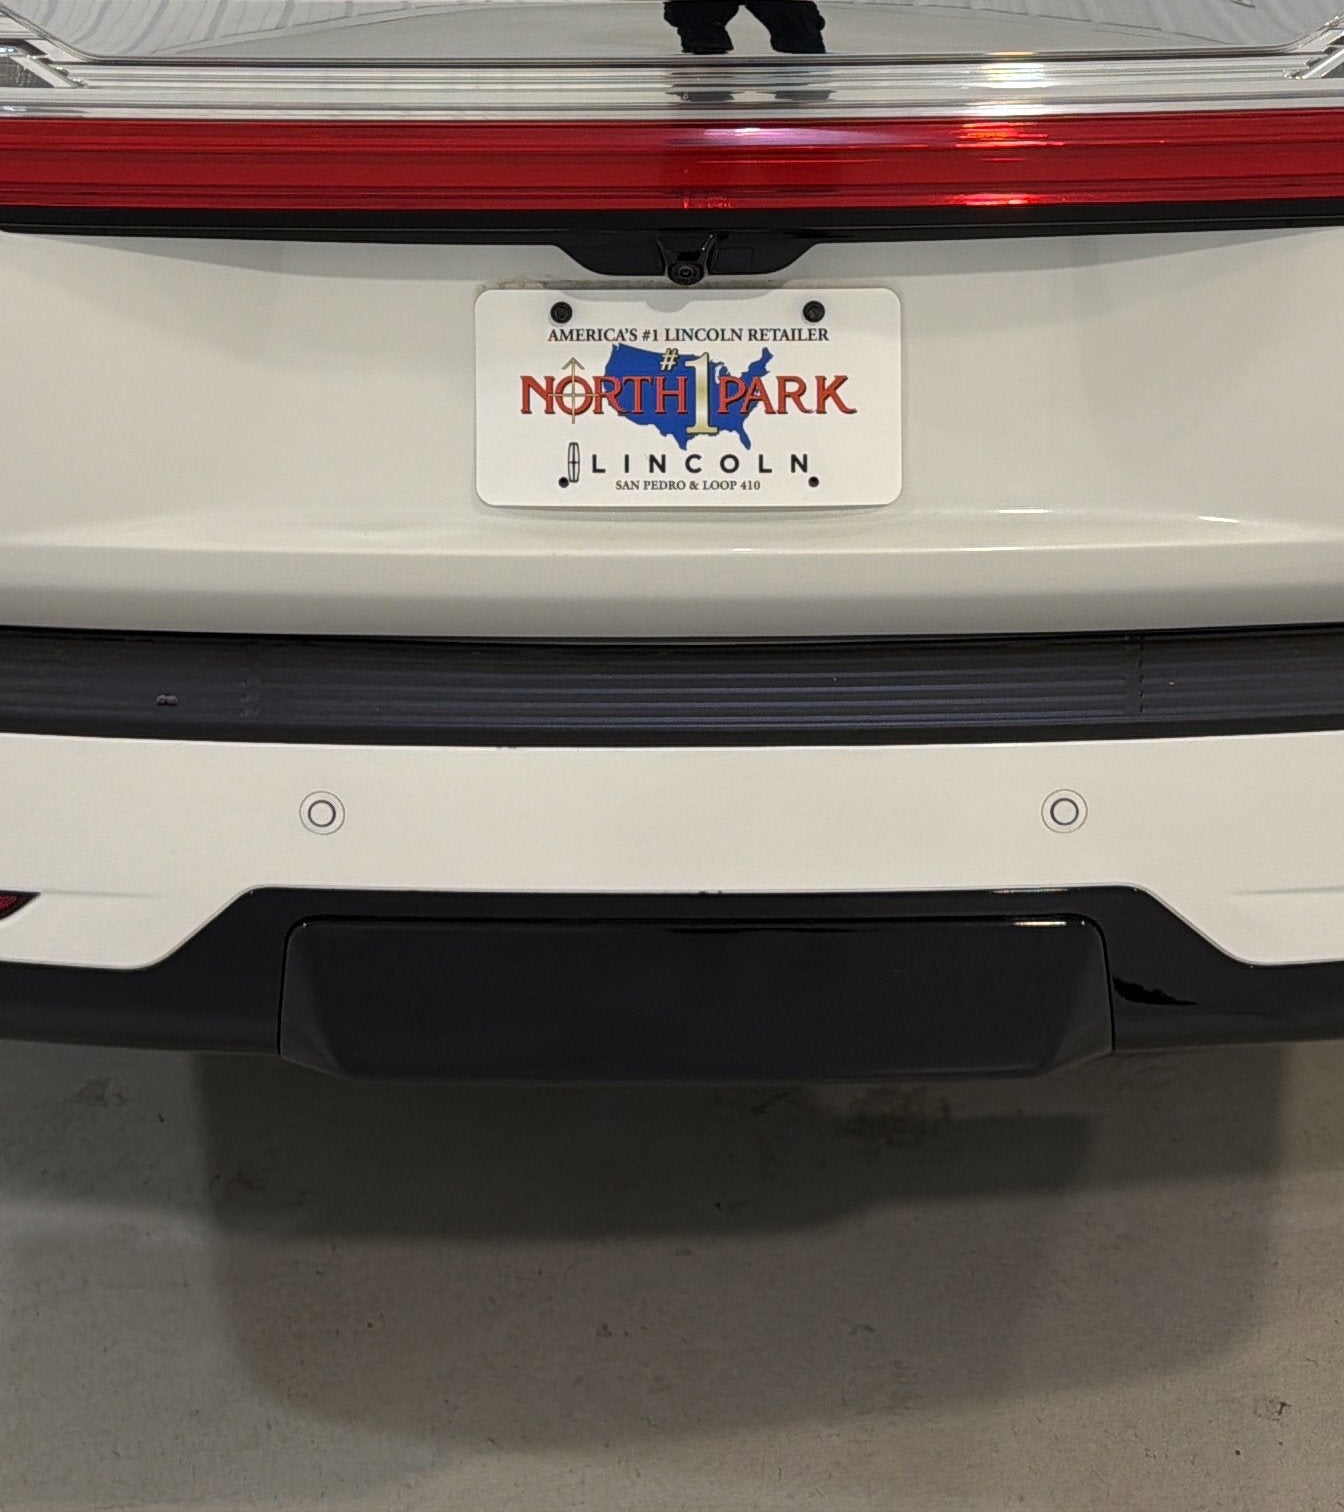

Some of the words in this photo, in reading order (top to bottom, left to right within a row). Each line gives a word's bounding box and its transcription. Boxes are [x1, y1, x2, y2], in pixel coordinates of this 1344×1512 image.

[547, 328, 638, 342] AMERICA'S
[642, 329, 659, 342] #1
[665, 328, 744, 342] LINCOLN
[747, 327, 830, 341] RETAILER
[520, 375, 688, 416] NORTH
[717, 374, 858, 415] PARK
[591, 453, 809, 474] LINCOLN
[615, 479, 641, 491] SAN
[643, 479, 687, 491] PEDRO
[689, 479, 699, 491] &
[702, 479, 738, 491] LOOP
[740, 479, 761, 491] 410
